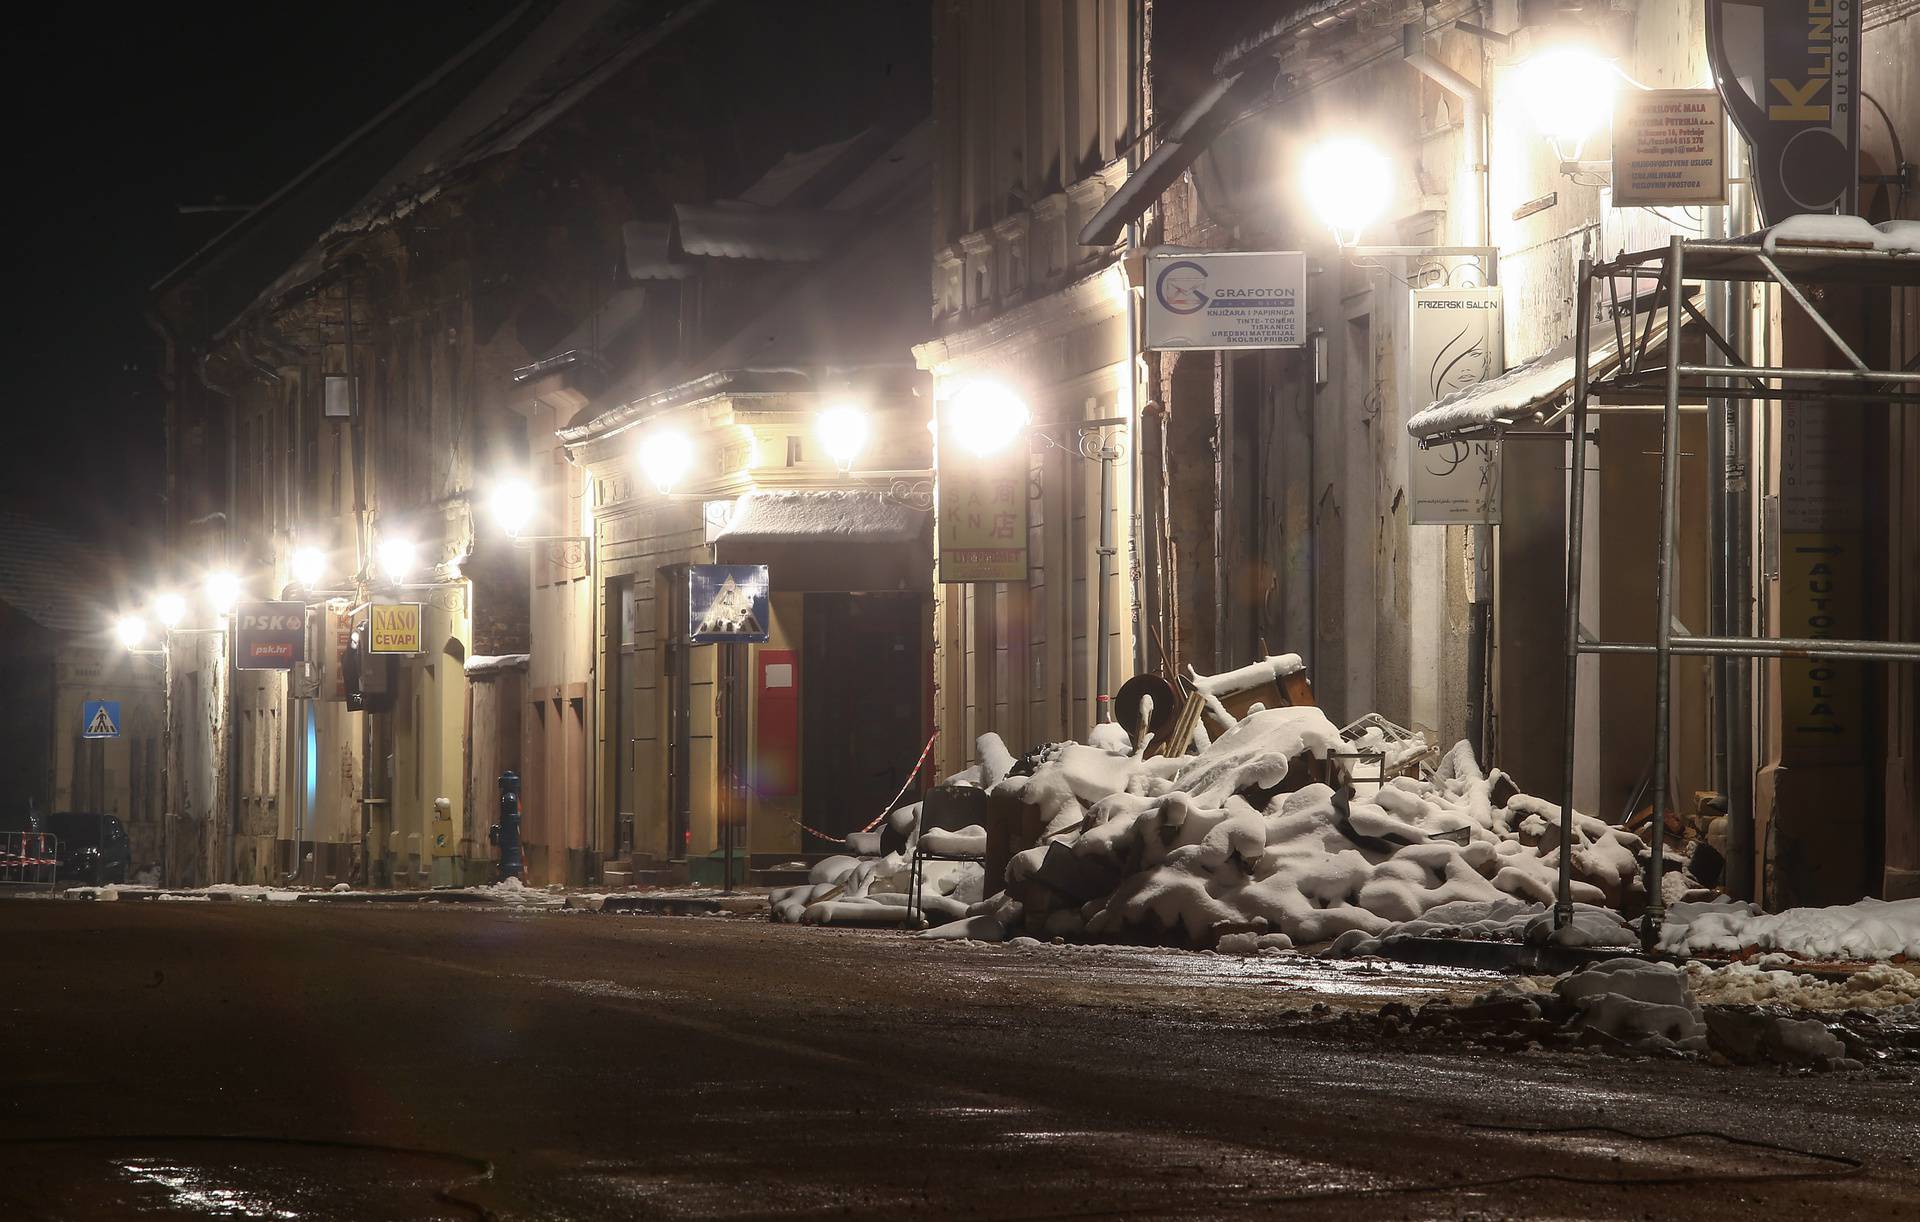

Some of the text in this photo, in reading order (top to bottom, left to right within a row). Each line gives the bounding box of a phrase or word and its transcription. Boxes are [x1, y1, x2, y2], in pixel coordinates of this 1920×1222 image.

[1684, 103, 1706, 113] MALA
[1215, 288, 1295, 298] GRAFOTON
[1417, 301, 1464, 309] FRIZERSKI
[1207, 309, 1246, 317] KNJIŽARA
[241, 615, 285, 630] PSK
[376, 610, 415, 630] NASO
[1808, 562, 1835, 717] AUTOOLA
[256, 645, 288, 655] psk.hr
